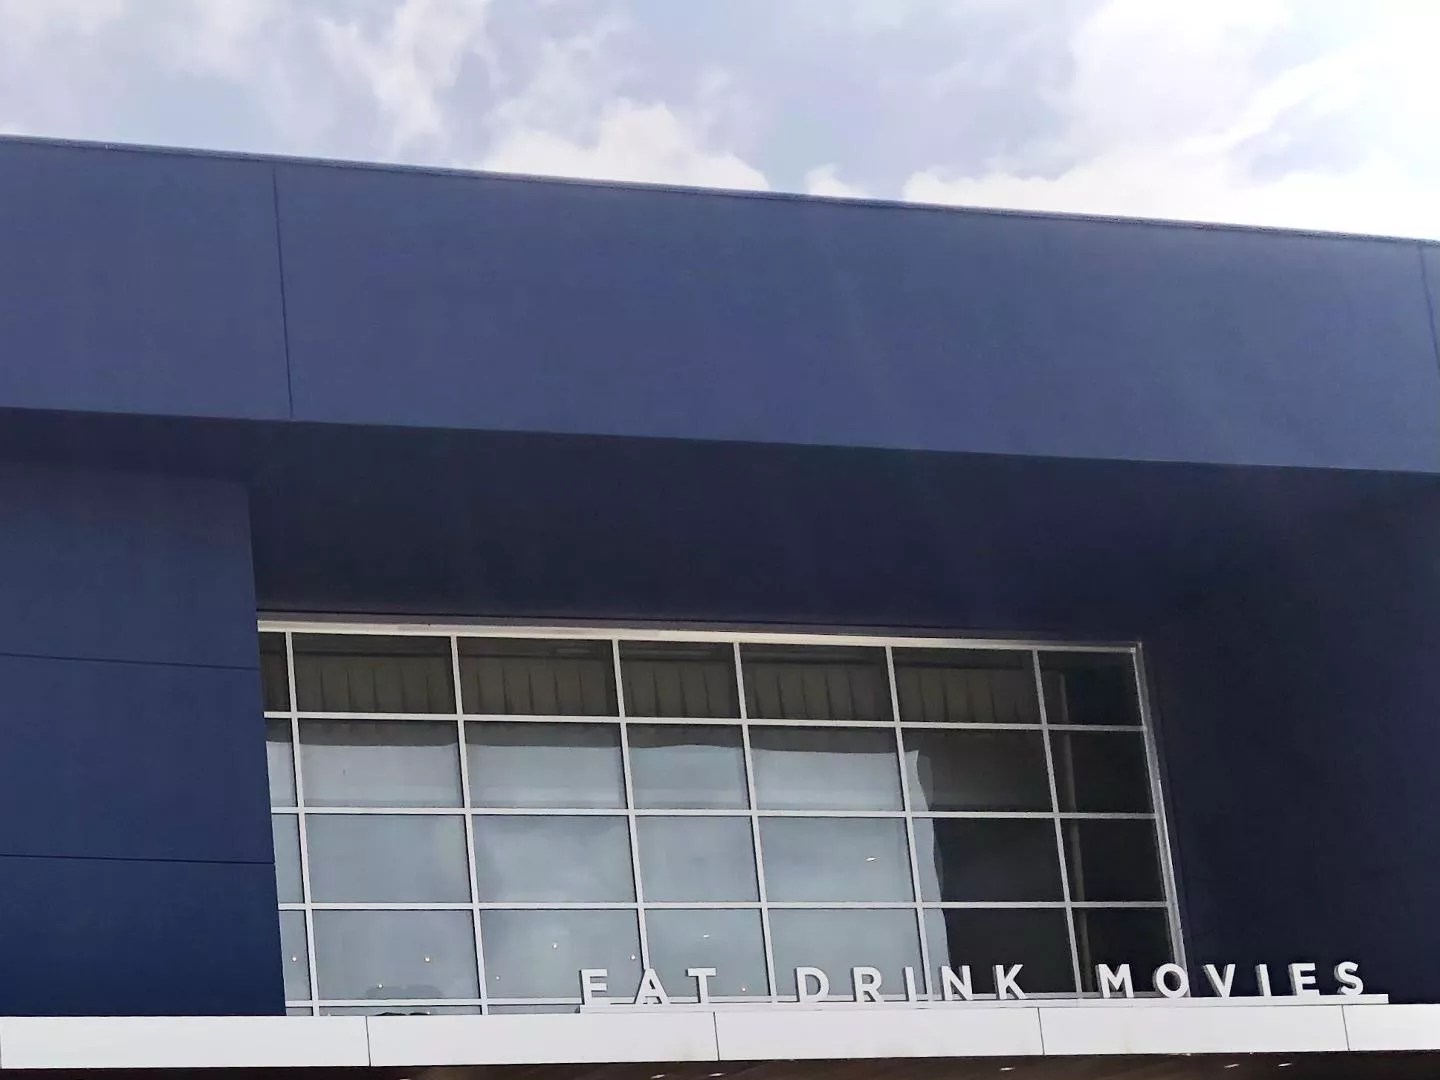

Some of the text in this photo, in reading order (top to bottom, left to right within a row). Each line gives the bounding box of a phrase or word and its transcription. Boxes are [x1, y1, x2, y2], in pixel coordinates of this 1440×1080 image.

[579, 961, 1364, 1005] EAT DRINK MOVIES
